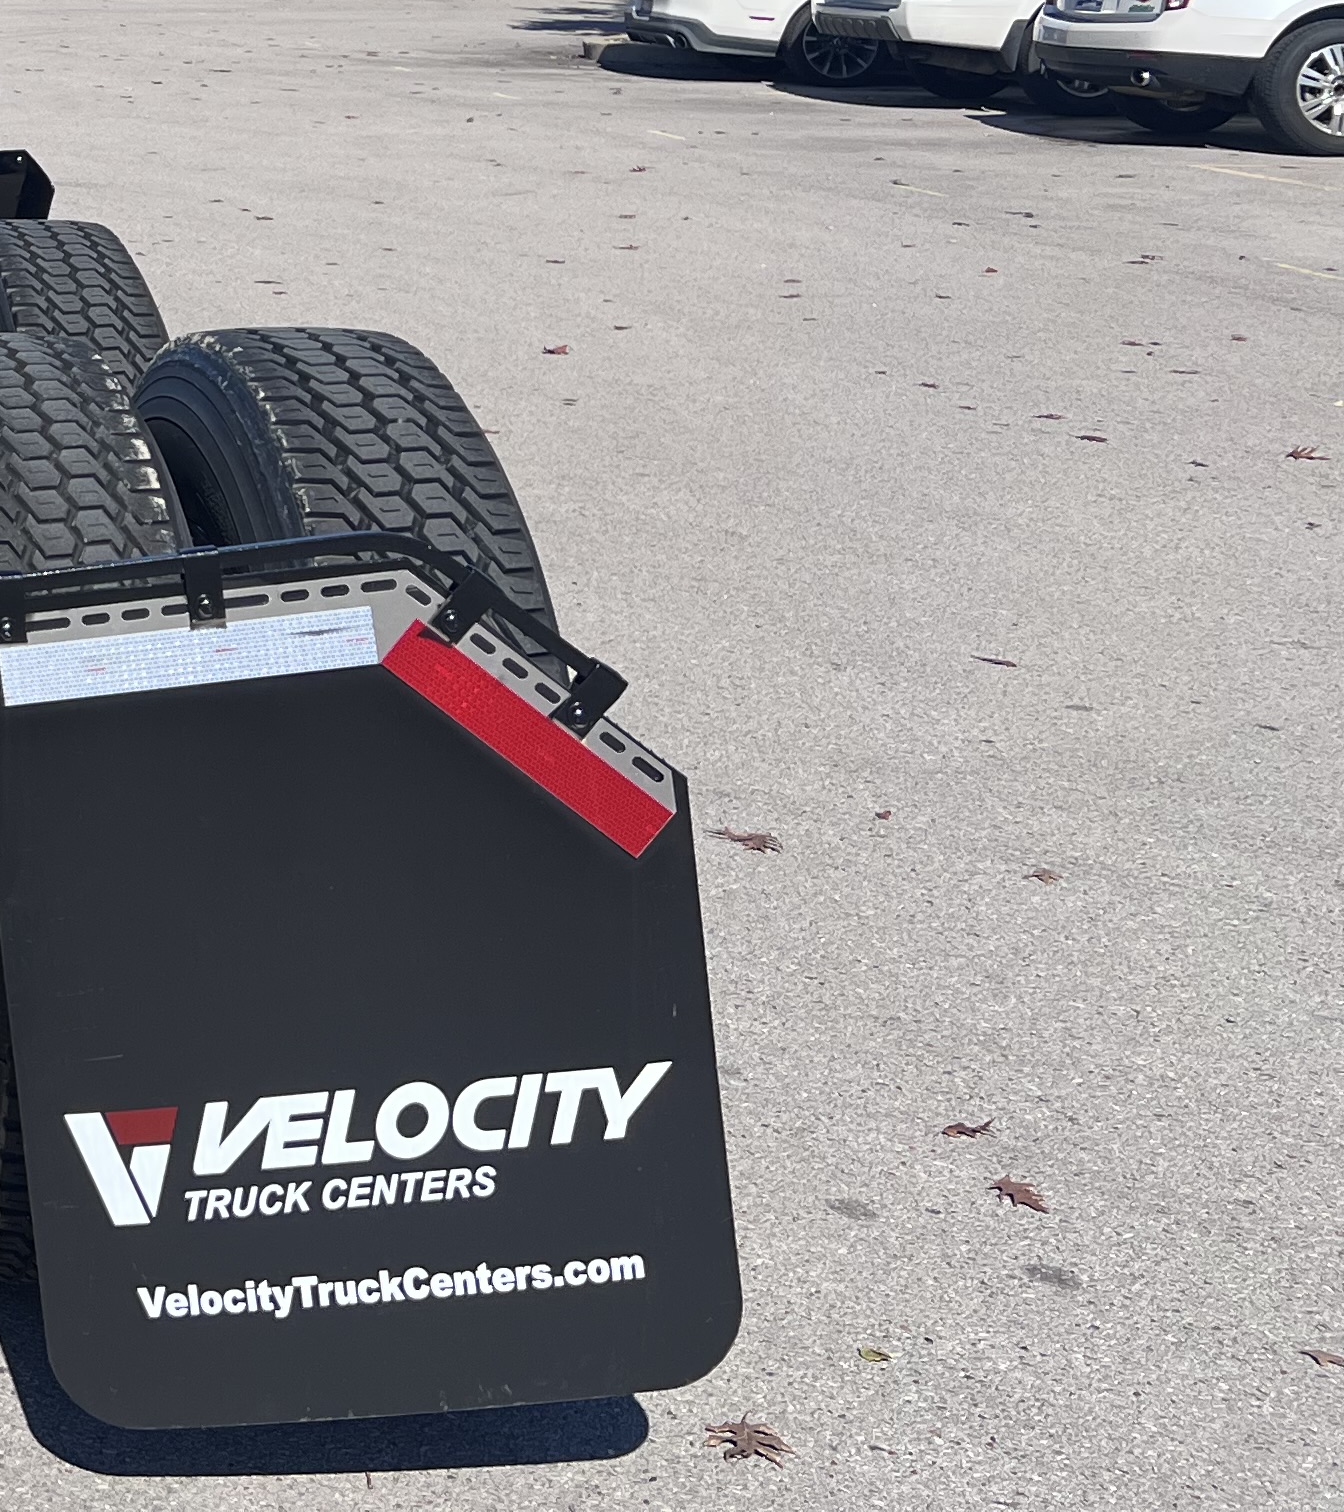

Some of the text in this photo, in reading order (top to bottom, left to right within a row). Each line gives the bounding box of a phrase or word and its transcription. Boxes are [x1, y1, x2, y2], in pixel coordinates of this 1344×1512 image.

[193, 1061, 673, 1176] VELOCITY
[183, 1165, 497, 1222] TRUCK CENTERS
[137, 1254, 646, 1319] VelocityTruckCenters.com
